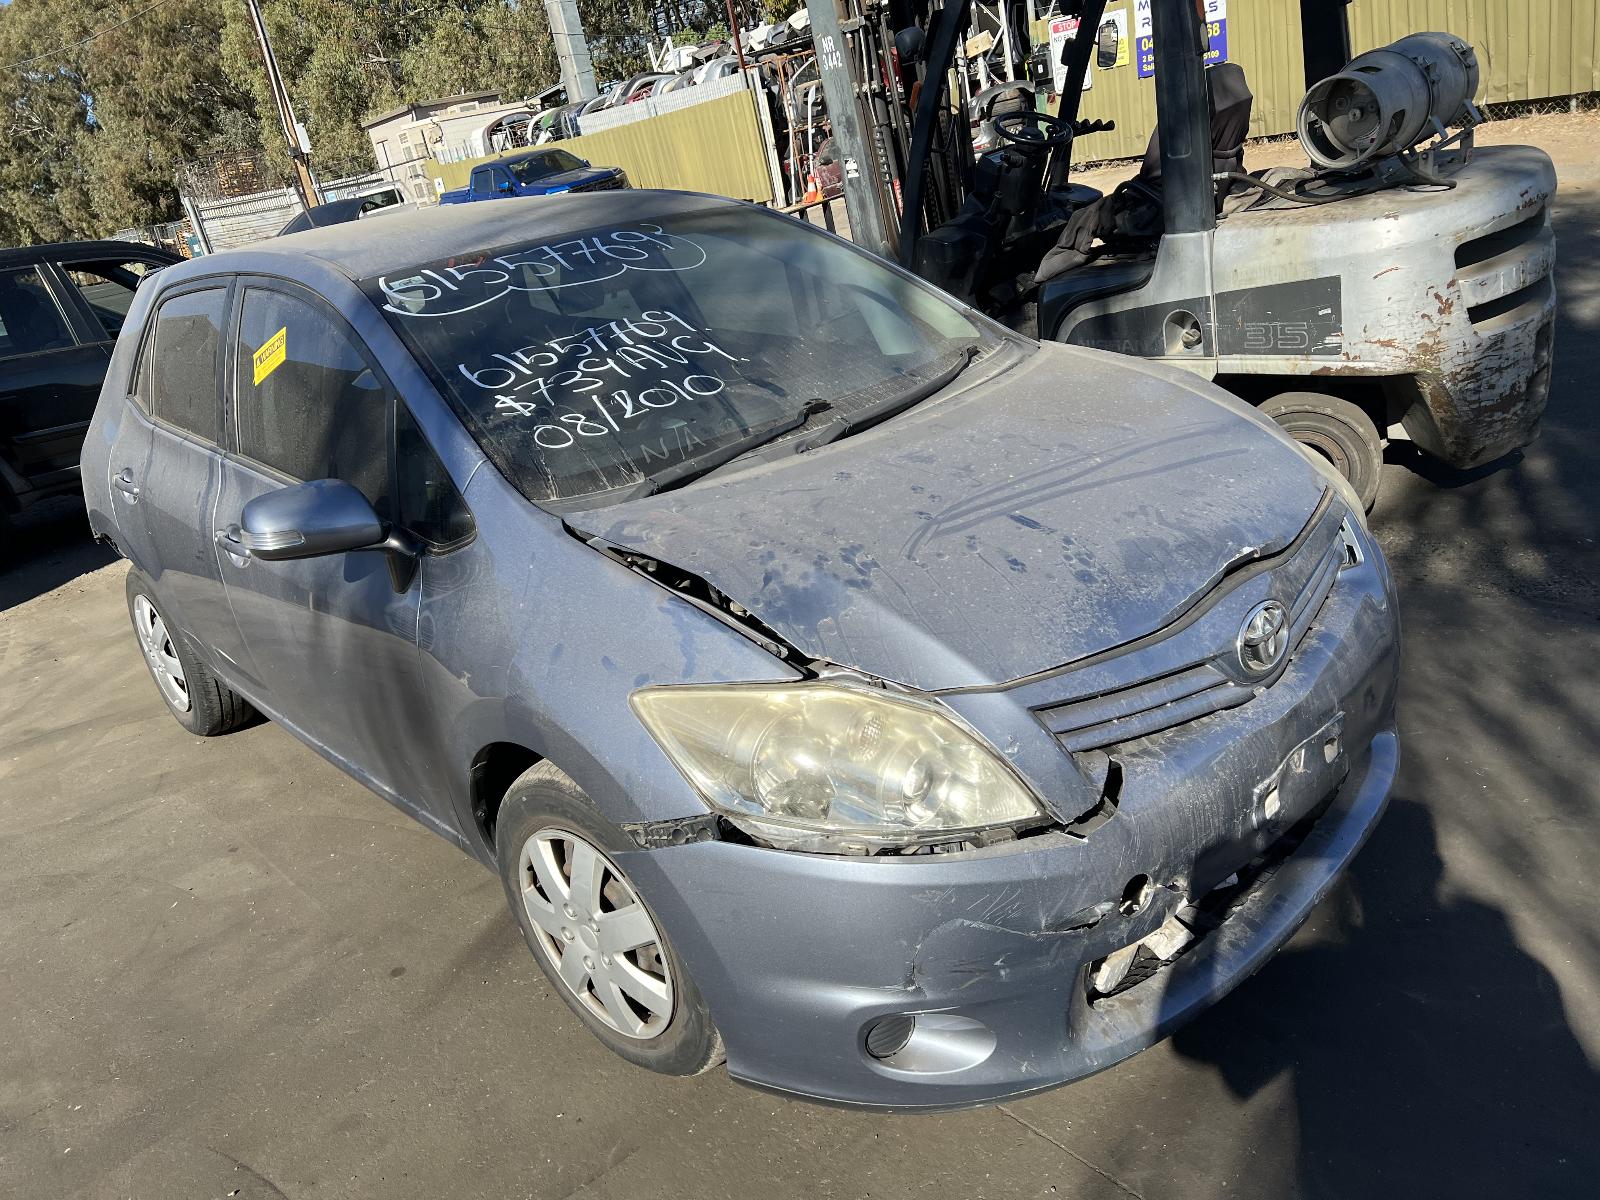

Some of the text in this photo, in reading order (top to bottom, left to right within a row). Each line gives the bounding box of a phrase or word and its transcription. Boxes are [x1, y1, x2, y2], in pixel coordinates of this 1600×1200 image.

[1058, 19, 1077, 31] STOP
[822, 50, 843, 70] 3442
[1243, 322, 1309, 349] 35
[533, 374, 726, 448] 08/2010
